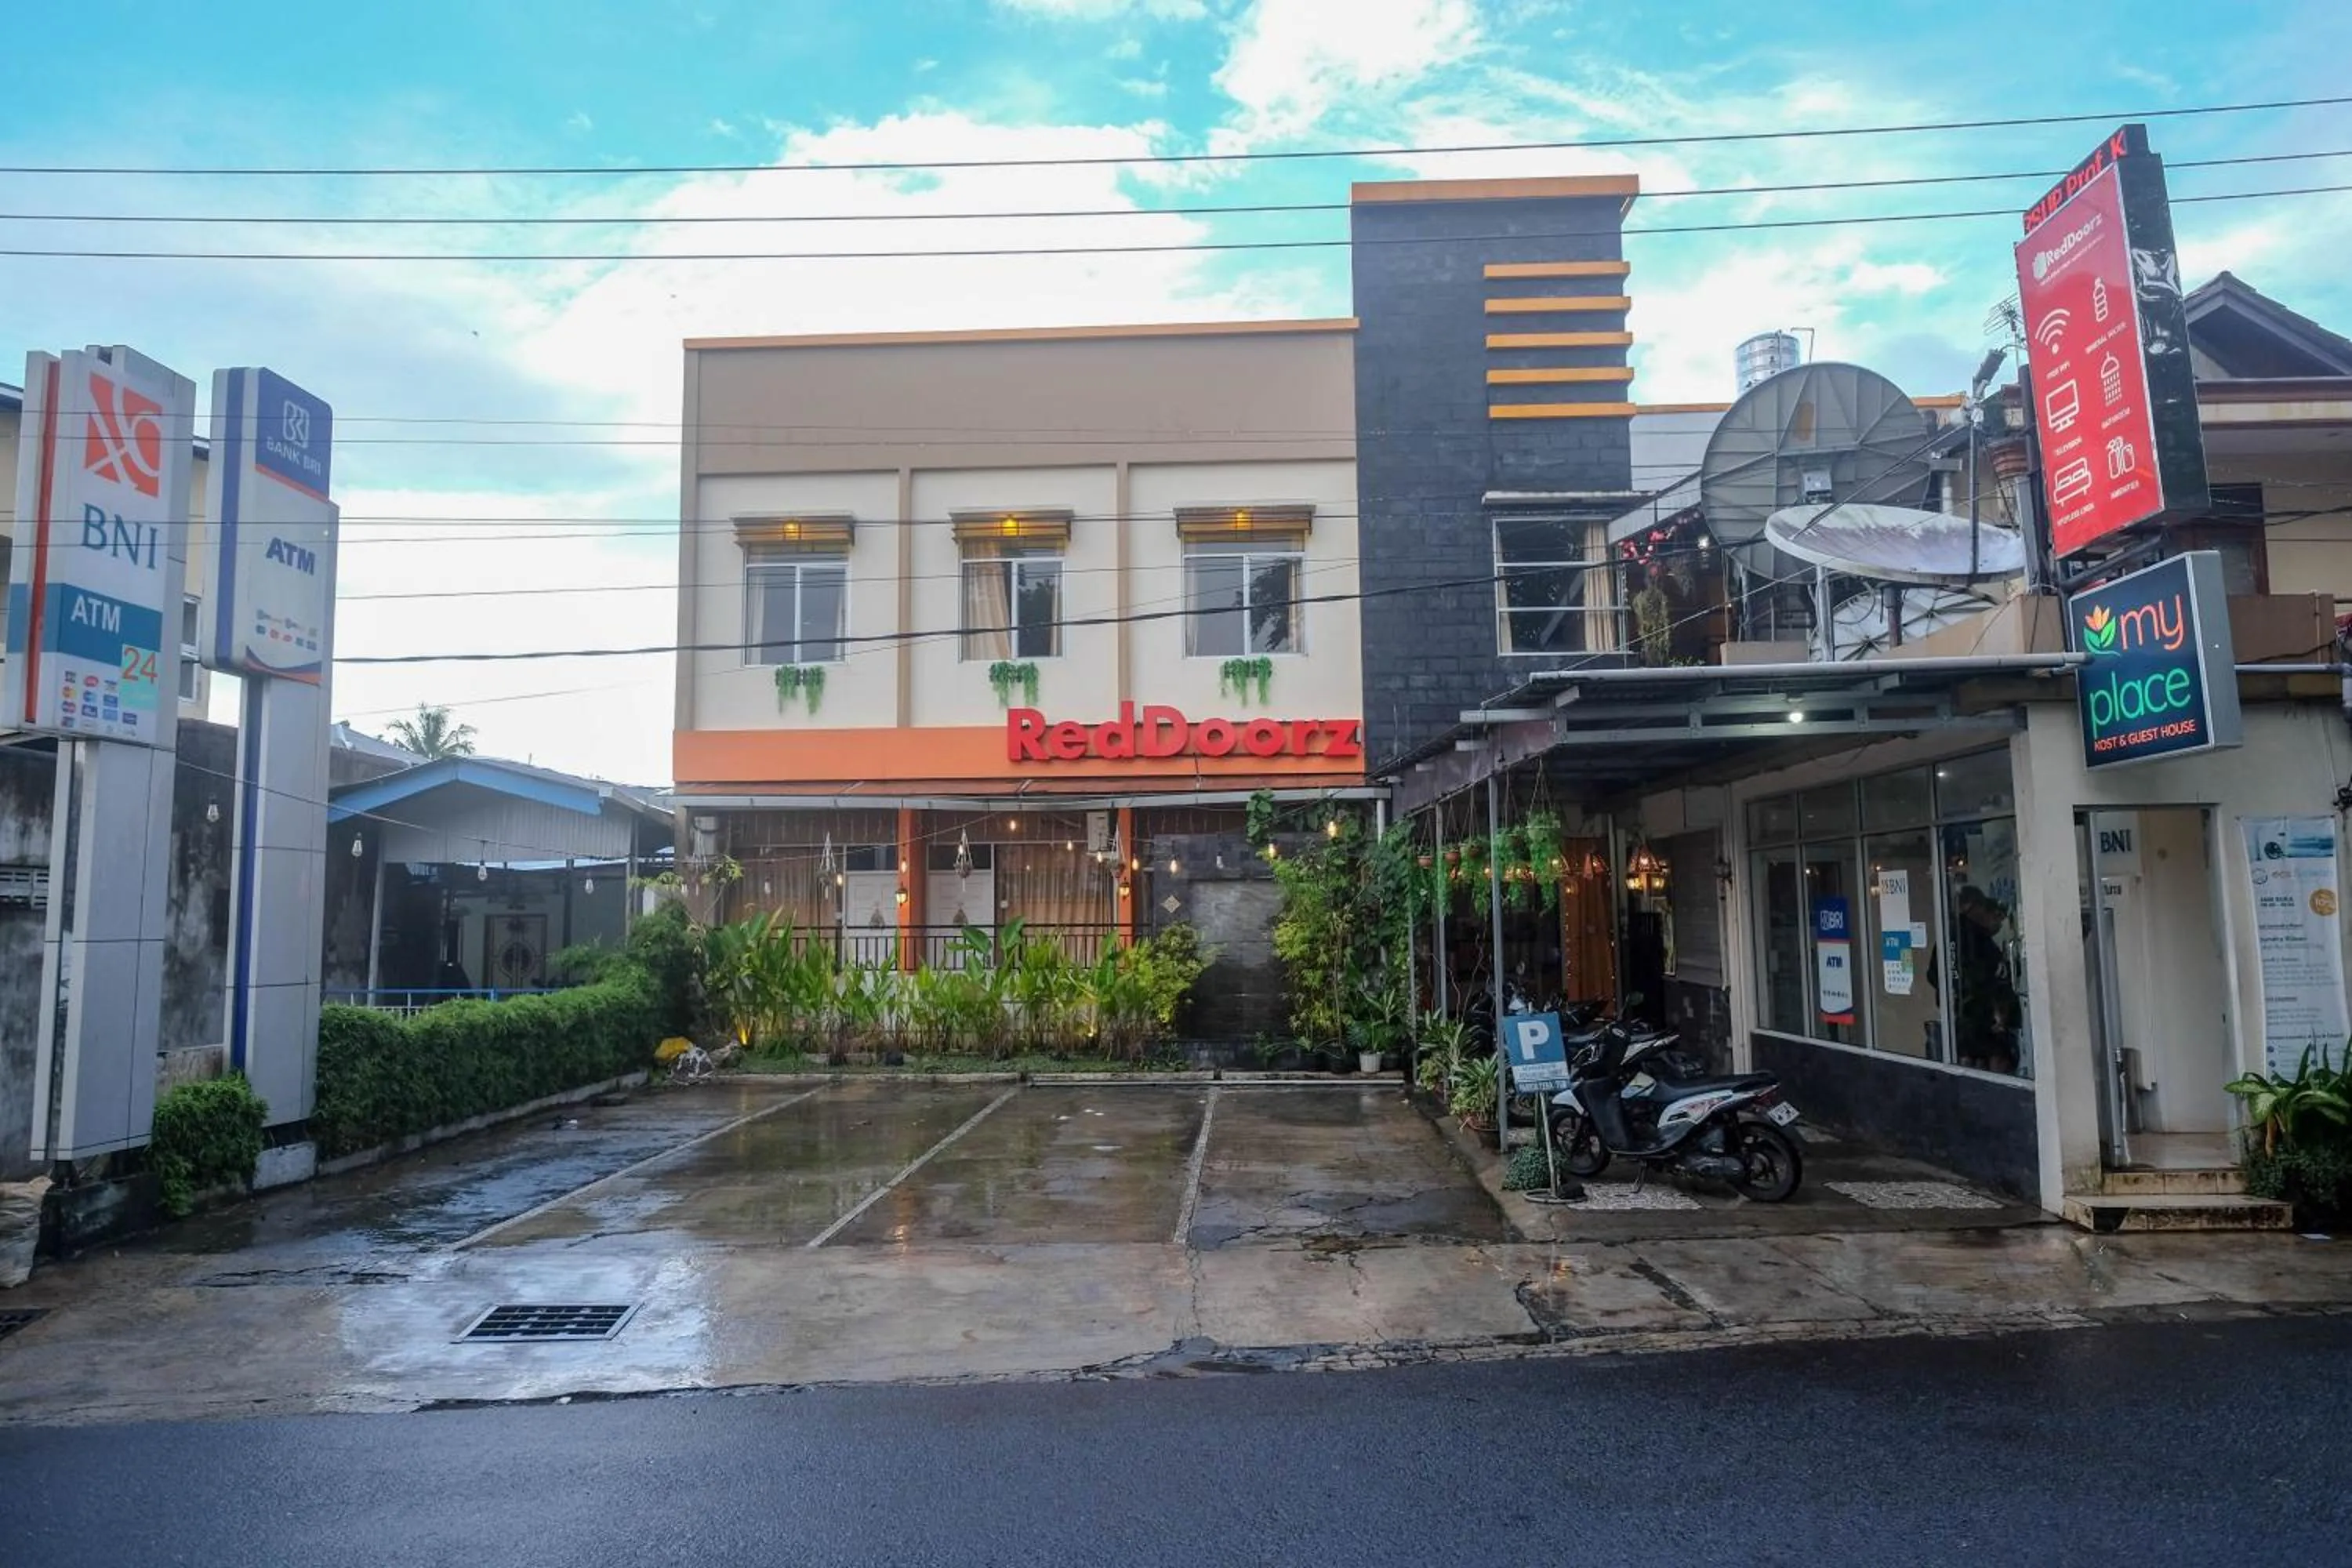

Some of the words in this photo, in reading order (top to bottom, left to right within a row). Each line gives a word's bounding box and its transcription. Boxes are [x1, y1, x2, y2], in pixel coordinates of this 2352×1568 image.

[2066, 150, 2103, 196] Prof
[2046, 212, 2103, 267] RedDoorz
[267, 437, 300, 466] BANK
[303, 456, 321, 475] BRI
[82, 503, 158, 570] BNI
[266, 537, 316, 576] ATM
[71, 595, 121, 633] ATM
[2120, 593, 2184, 652] my
[122, 647, 158, 684] 24
[2090, 667, 2191, 739] place
[1007, 699, 1360, 762] RedDoorz
[2094, 737, 2117, 752] KOST
[2119, 735, 2127, 747] &
[2128, 728, 2158, 744] GUEST
[2161, 720, 2196, 739] HOUSE
[2100, 828, 2132, 853] BNI
[1826, 956, 1844, 968] ATM
[1517, 1020, 1550, 1061] P
